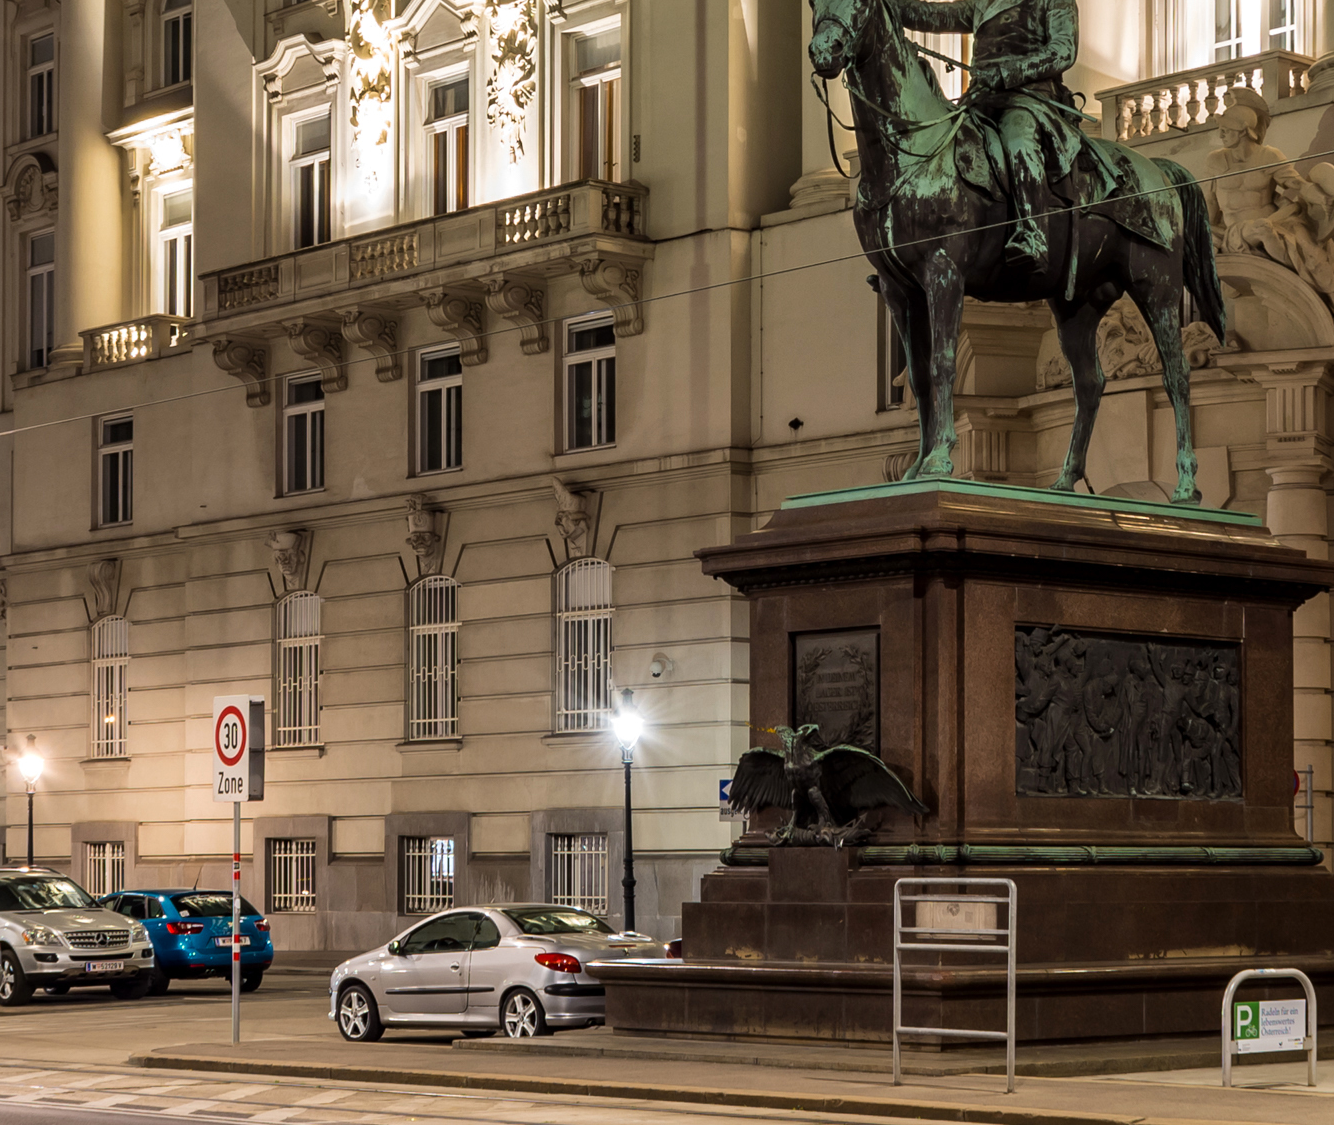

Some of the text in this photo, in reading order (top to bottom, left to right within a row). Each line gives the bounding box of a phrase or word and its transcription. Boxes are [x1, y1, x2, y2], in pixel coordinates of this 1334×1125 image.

[224, 722, 238, 750] 30
[218, 771, 244, 794] Zone
[1237, 1005, 1252, 1037] P
[1261, 1008, 1280, 1016] Radeln
[1281, 1007, 1289, 1015] für
[1261, 1018, 1295, 1026] lebenswertes
